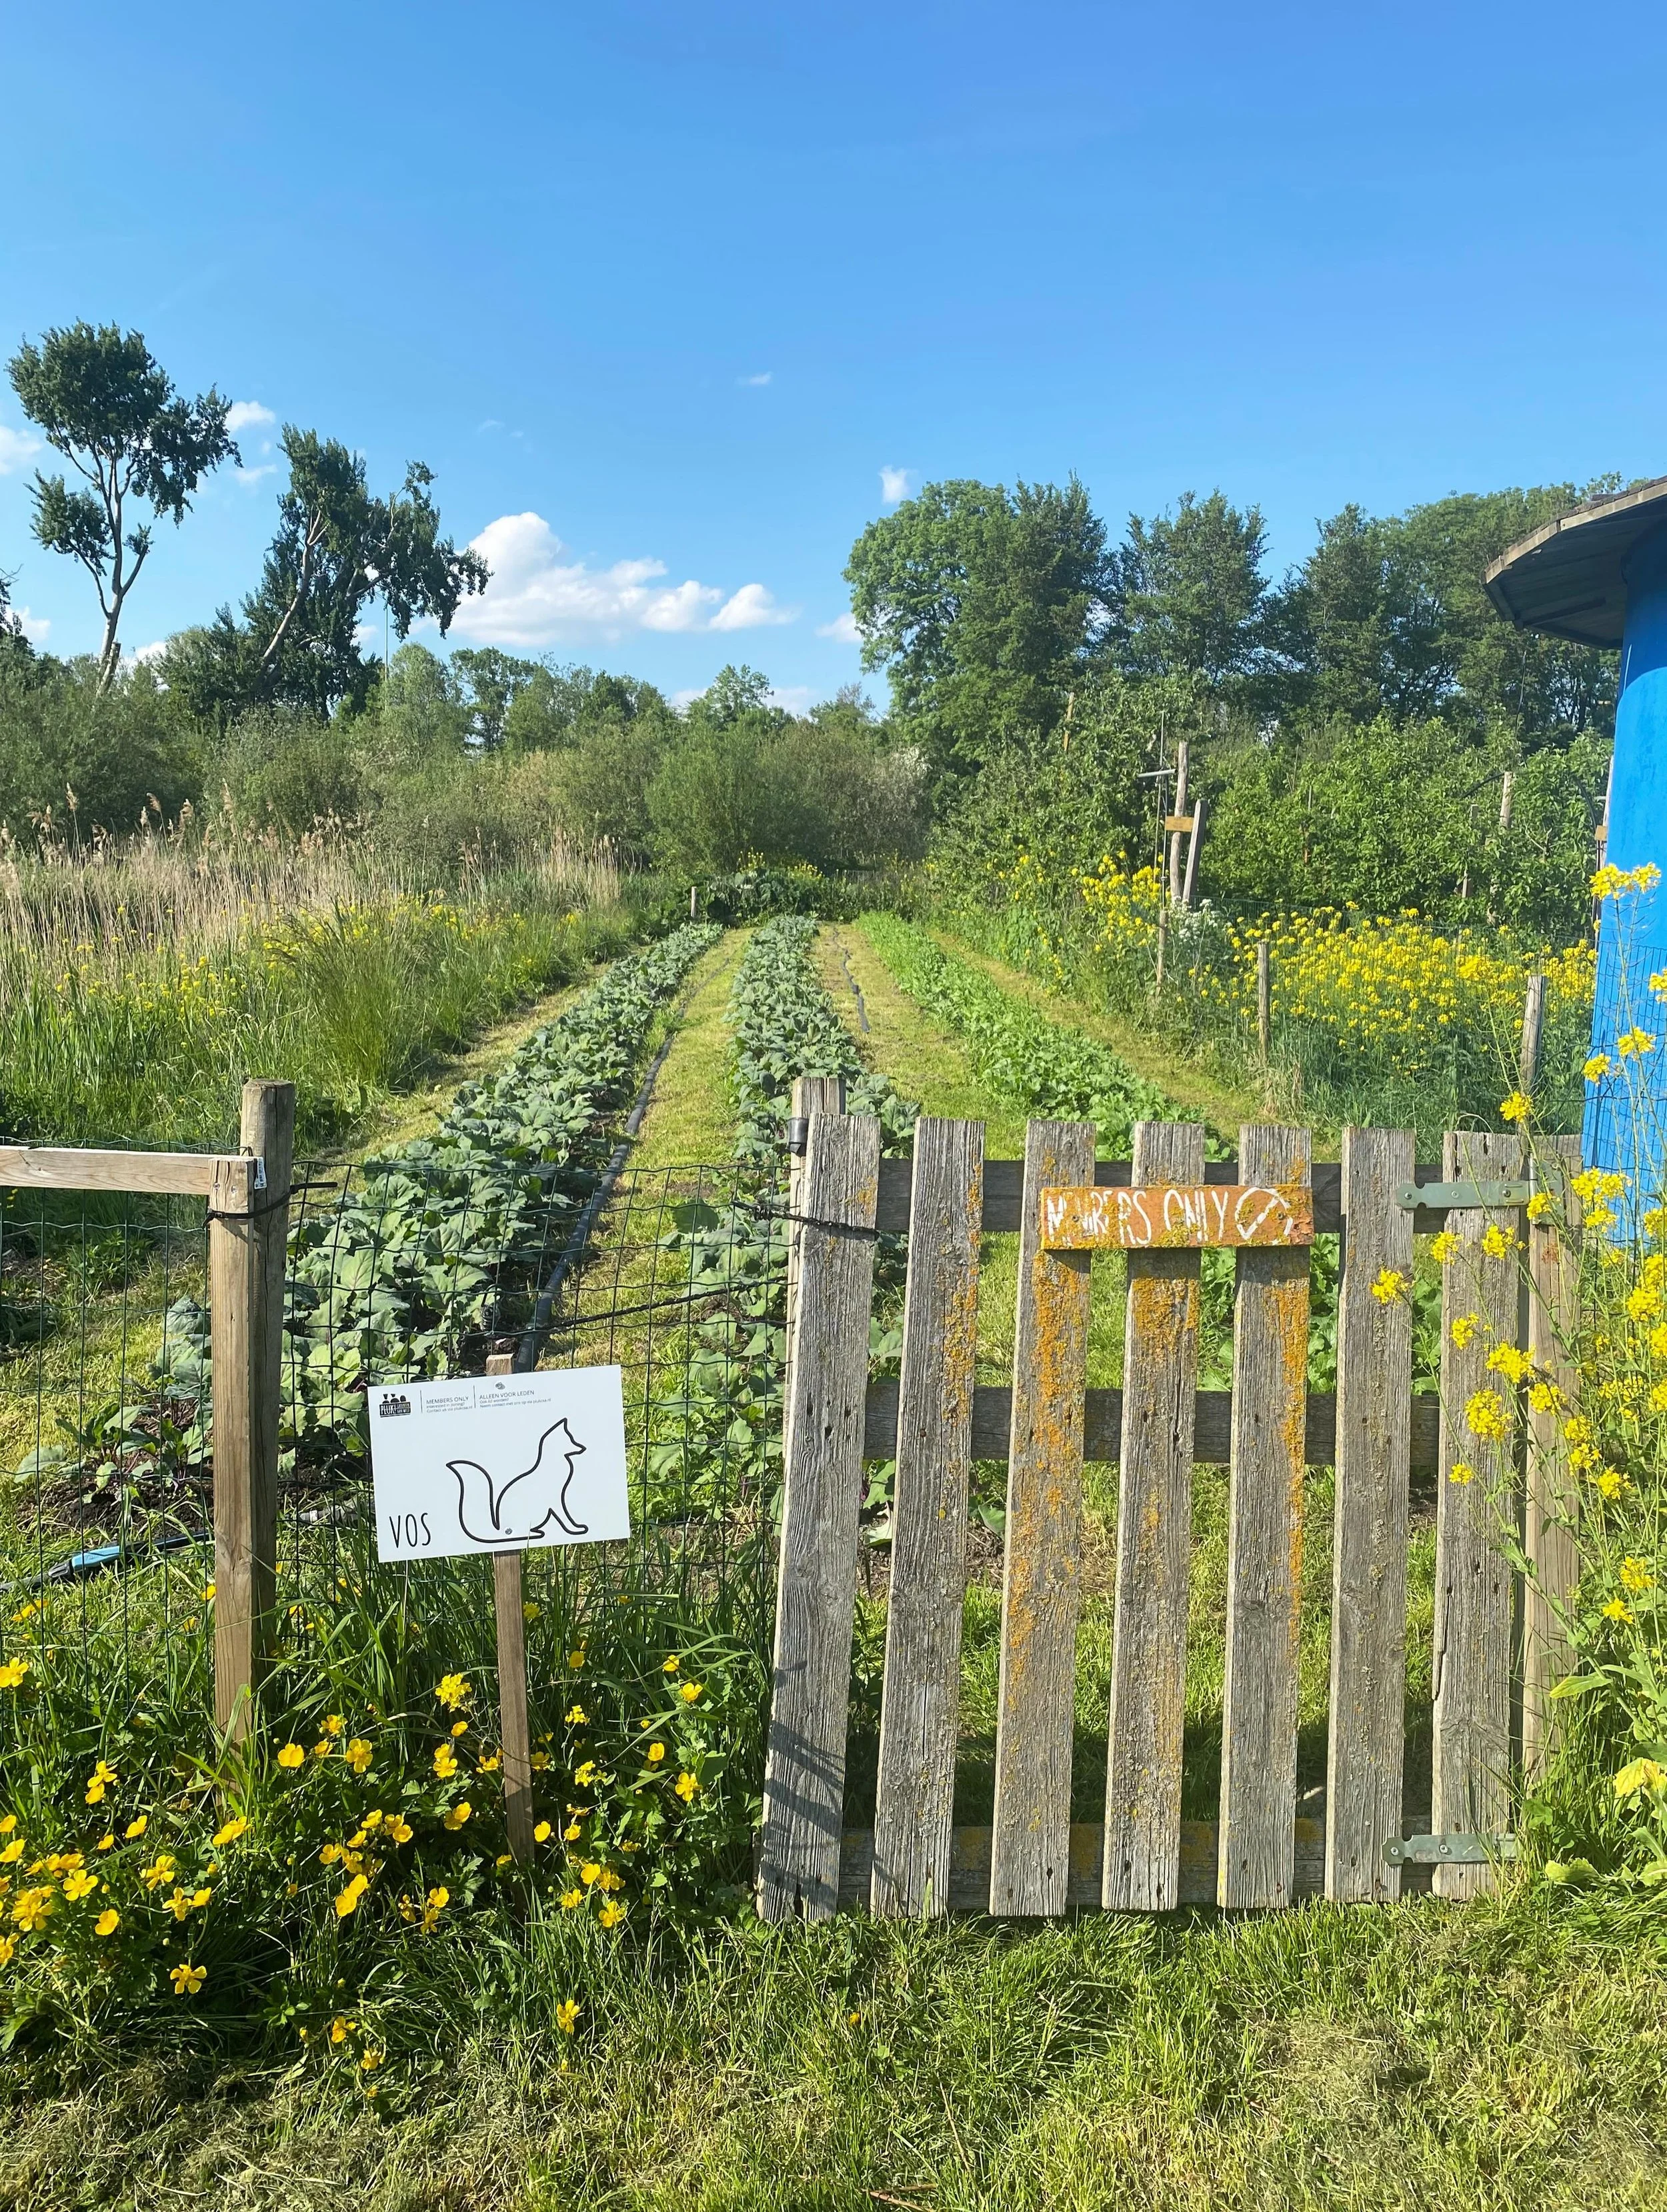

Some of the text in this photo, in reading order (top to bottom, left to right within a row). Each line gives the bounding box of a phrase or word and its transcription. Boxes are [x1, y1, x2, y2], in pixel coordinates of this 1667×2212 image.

[1047, 1190, 1152, 1246] MBERS
[381, 1404, 396, 1415] PLUK!
[389, 1512, 432, 1548] VOS
